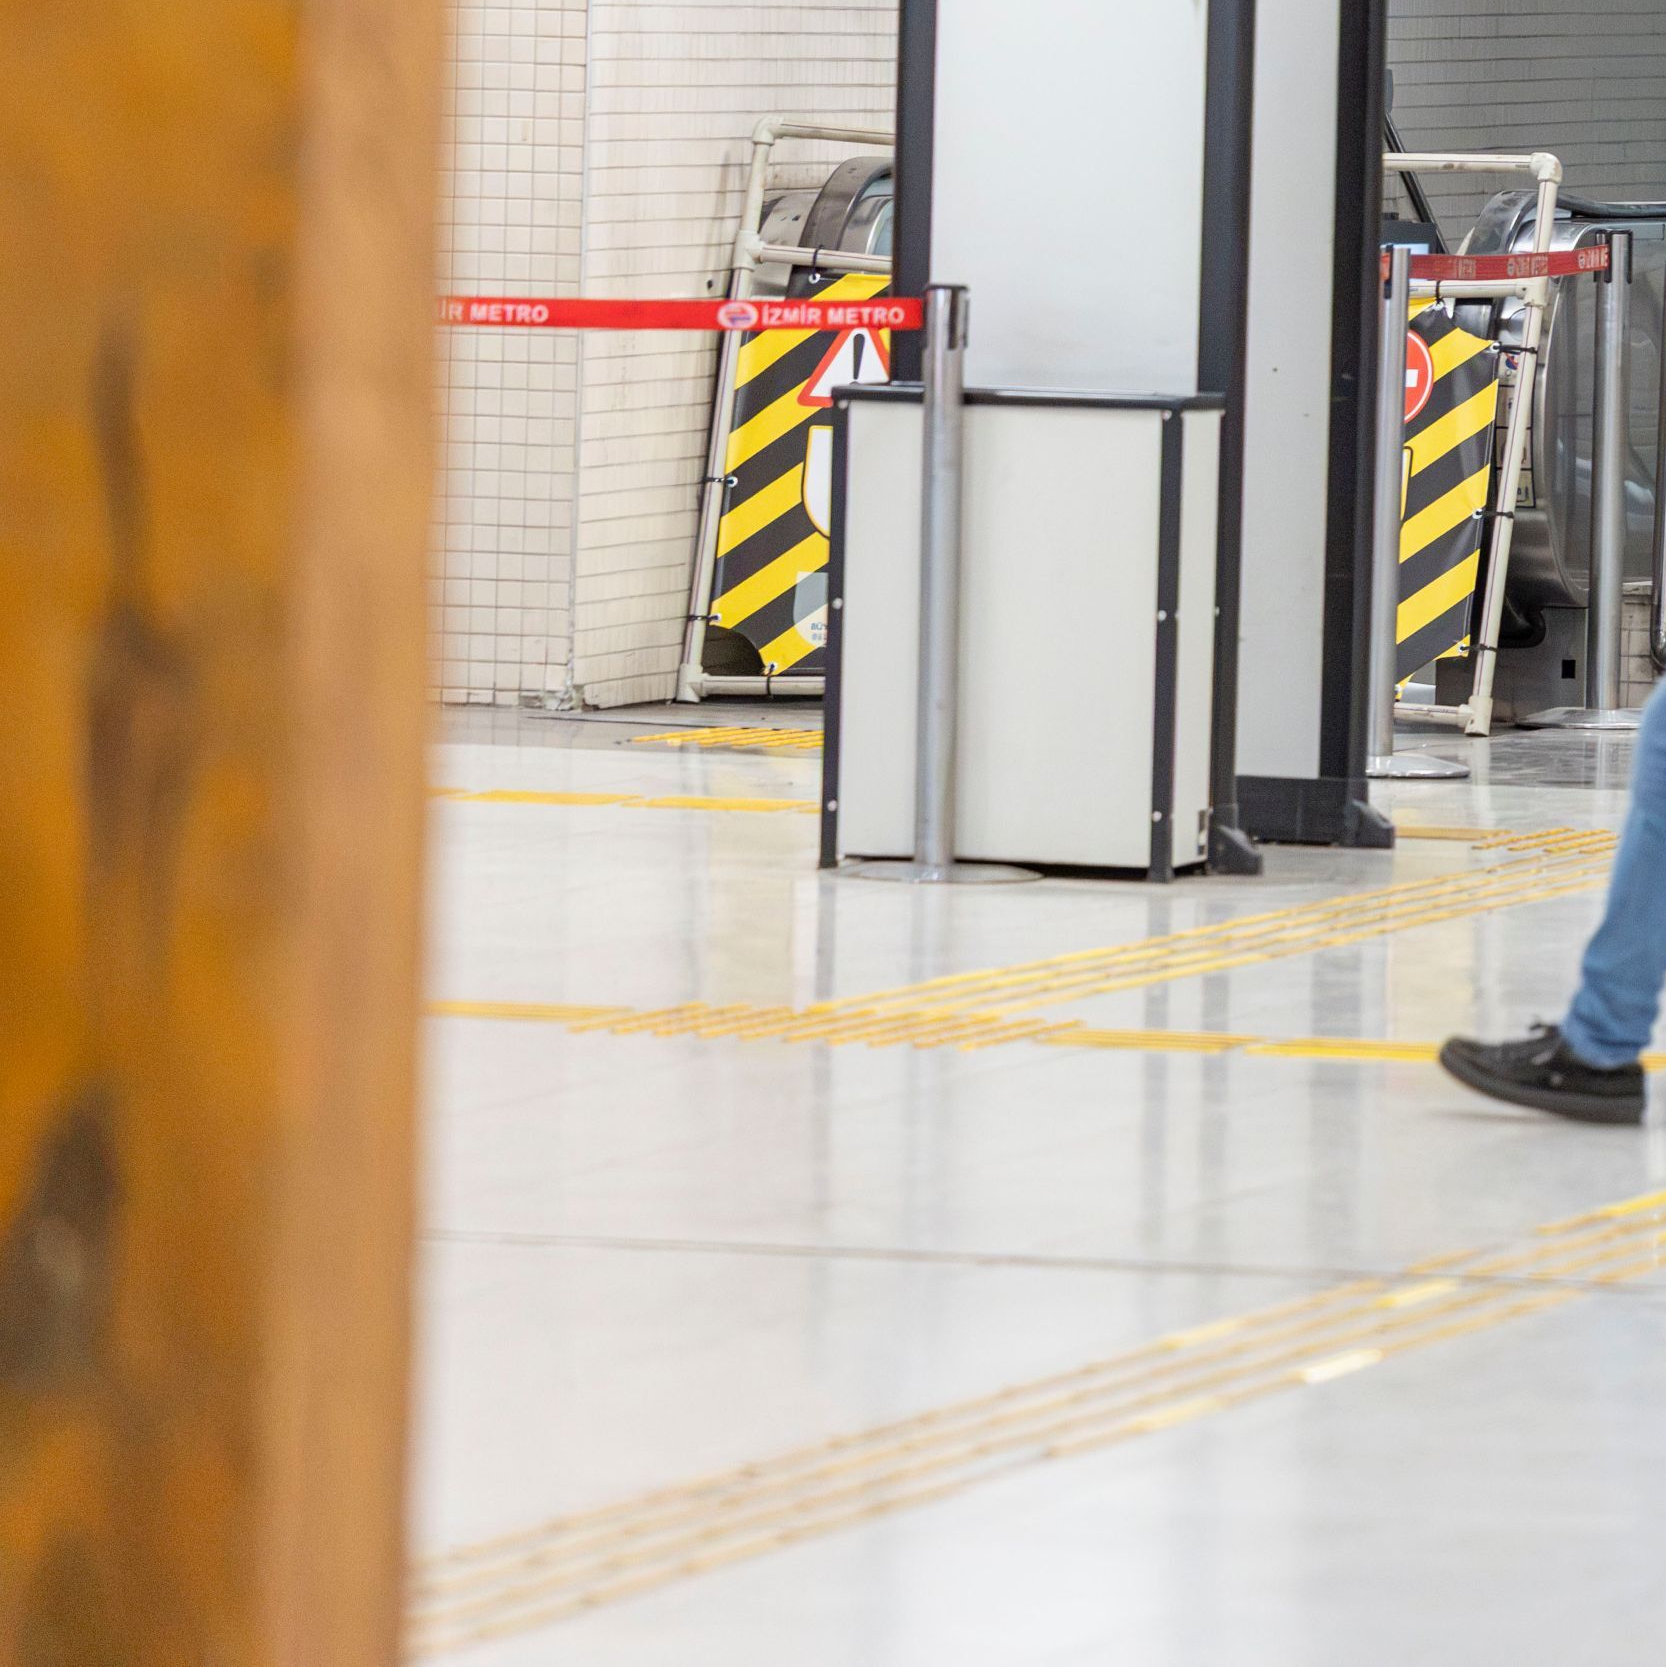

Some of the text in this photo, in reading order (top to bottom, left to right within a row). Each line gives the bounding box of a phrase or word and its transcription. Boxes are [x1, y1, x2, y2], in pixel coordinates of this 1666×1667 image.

[469, 302, 549, 324] METRO
[761, 303, 906, 326] İZMİR METRO
